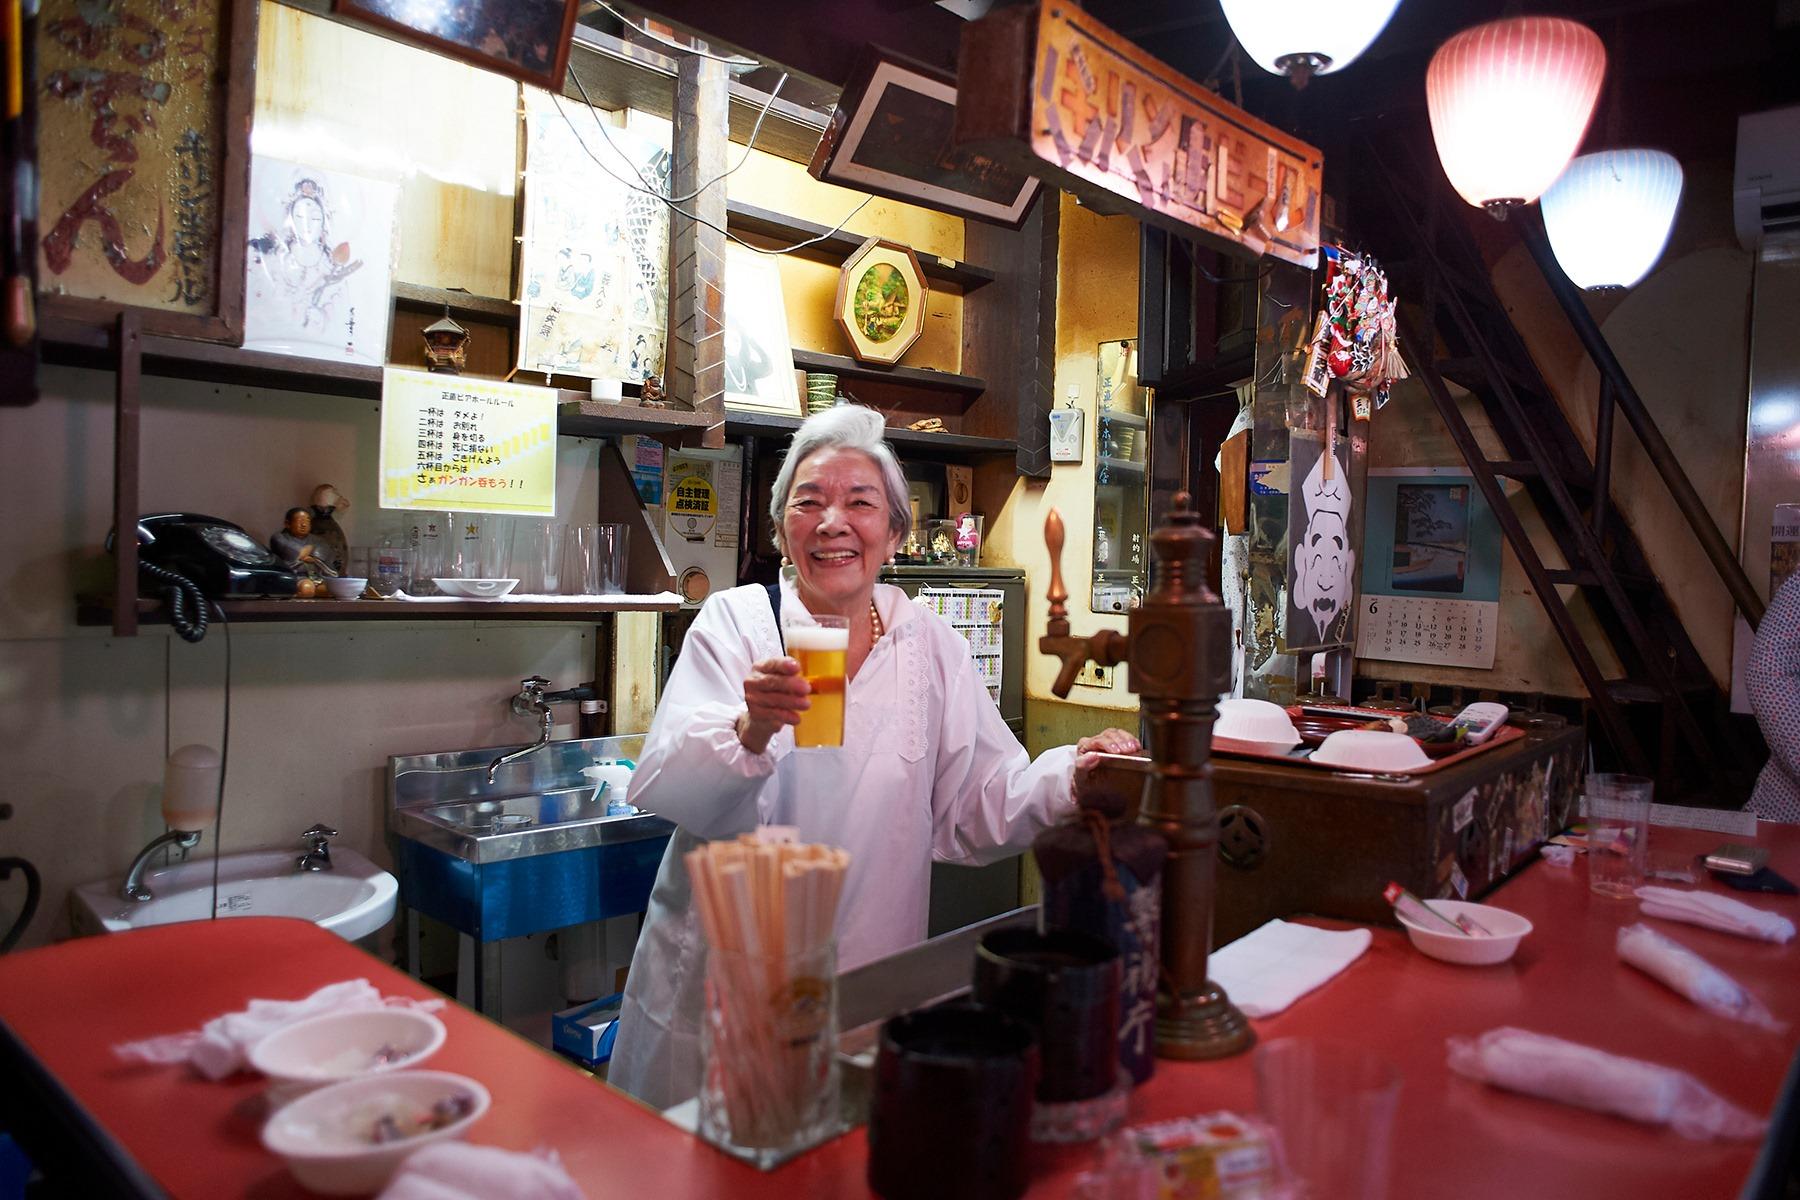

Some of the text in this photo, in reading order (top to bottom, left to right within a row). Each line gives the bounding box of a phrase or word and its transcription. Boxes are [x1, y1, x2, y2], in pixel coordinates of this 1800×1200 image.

[419, 407, 444, 418] 一杯は
[418, 417, 478, 432] 二杯は お別れ
[418, 428, 486, 444] 三杯は 身を切る
[417, 439, 494, 454] 四杯は 死に損ない
[417, 450, 443, 461] 五杯は
[417, 462, 468, 474] 六杯目からは
[676, 487, 710, 500] 自主管理
[675, 500, 710, 512] 点検済証
[1131, 533, 1140, 565] 射的場
[1369, 601, 1378, 614] 6
